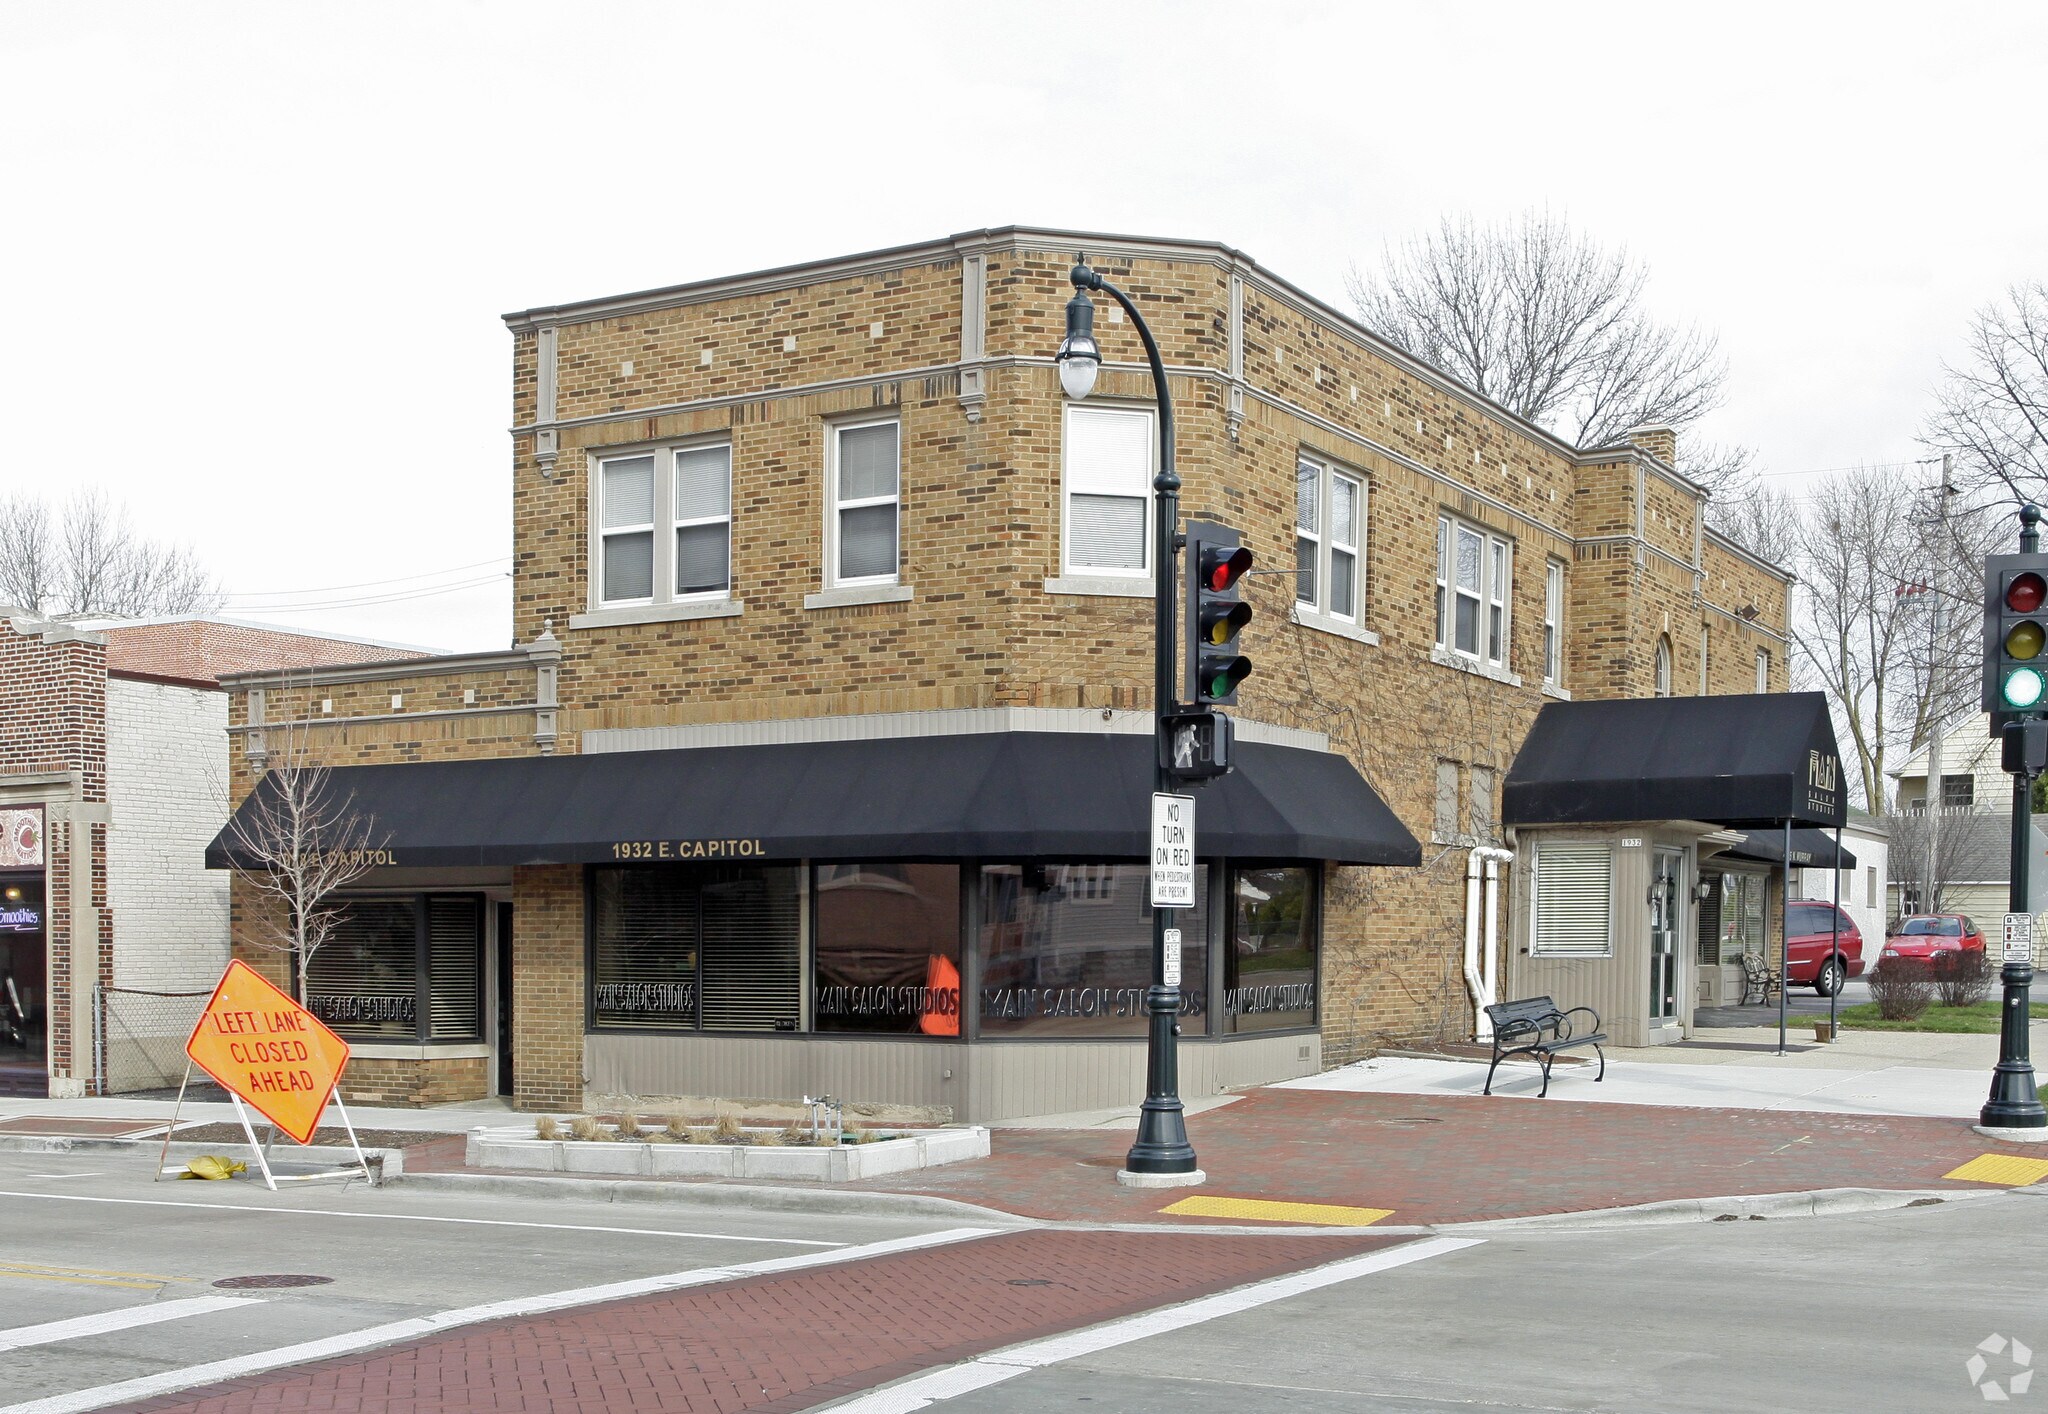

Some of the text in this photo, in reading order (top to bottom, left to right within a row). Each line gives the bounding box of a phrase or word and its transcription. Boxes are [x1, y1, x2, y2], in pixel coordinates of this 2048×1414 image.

[1168, 804, 1180, 822] NO
[1162, 825, 1185, 844] TURN
[16, 846, 37, 859] NATION
[327, 850, 397, 865] CAPITOL
[612, 840, 765, 858] 1932 E. CAPITOL
[1156, 847, 1190, 866] ON RED
[1154, 871, 1191, 883] WHEN PEDESTRIANS
[1158, 886, 1188, 898] ARE PRESENT
[816, 986, 959, 1015] MAIN SALON STUDIOS
[984, 988, 1201, 1017] MAIN SALON STUOS
[1223, 983, 1313, 1017] MAIN SALON STUDIOS
[213, 1011, 307, 1034] LEFT LANE
[230, 1040, 308, 1064] CLOSED
[249, 1070, 315, 1093] AHEAD
